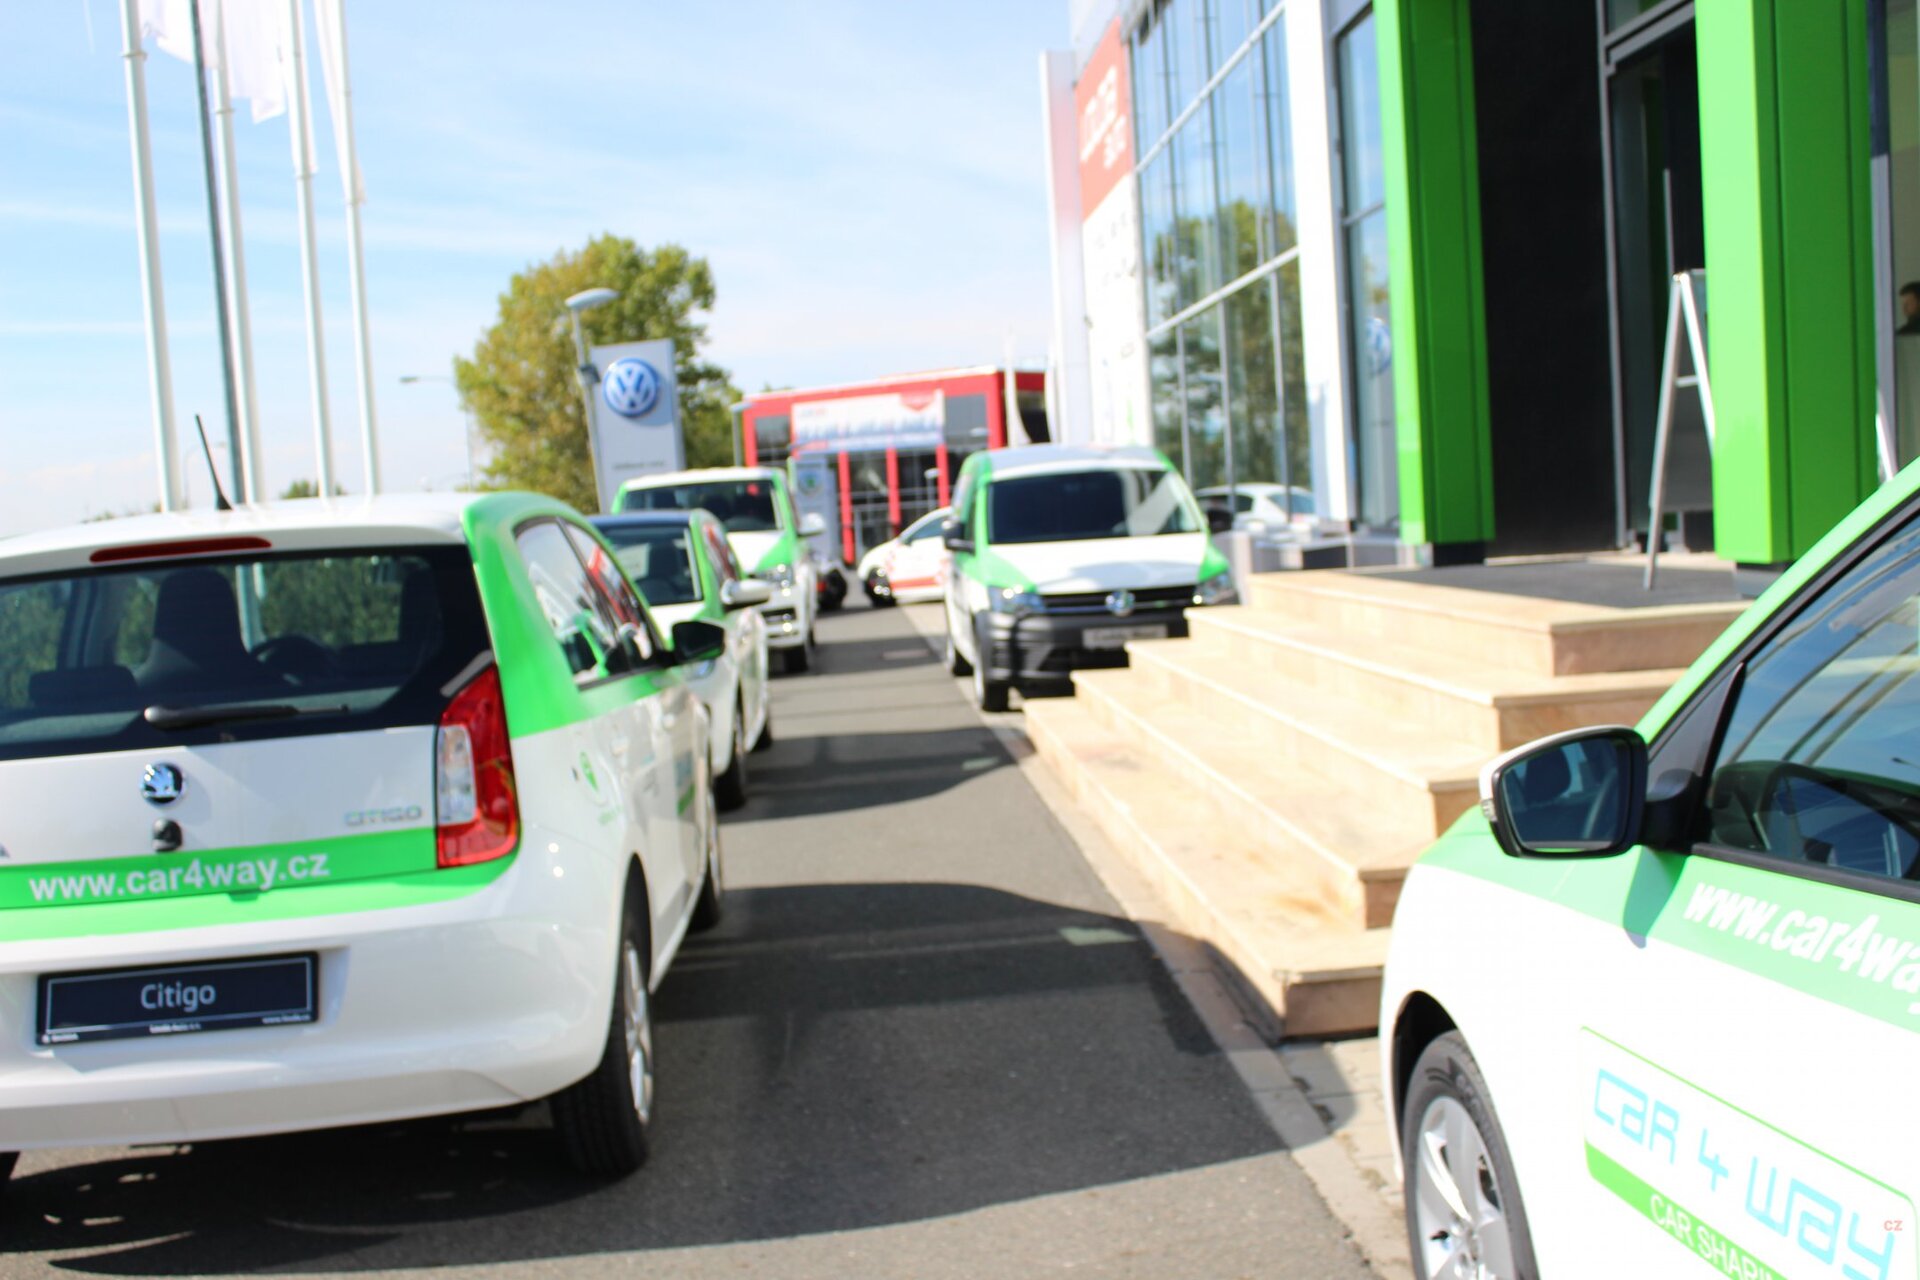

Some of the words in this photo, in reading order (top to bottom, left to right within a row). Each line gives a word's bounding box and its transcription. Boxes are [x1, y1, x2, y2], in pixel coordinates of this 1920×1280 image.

[29, 853, 331, 901] www.car4way.cz
[1683, 882, 1920, 1015] www.car4wa
[140, 983, 216, 1012] Citigo
[1698, 1128, 1729, 1192] 4
[1650, 1194, 1695, 1248] CAR
[1697, 1225, 1773, 1280] SHAR
